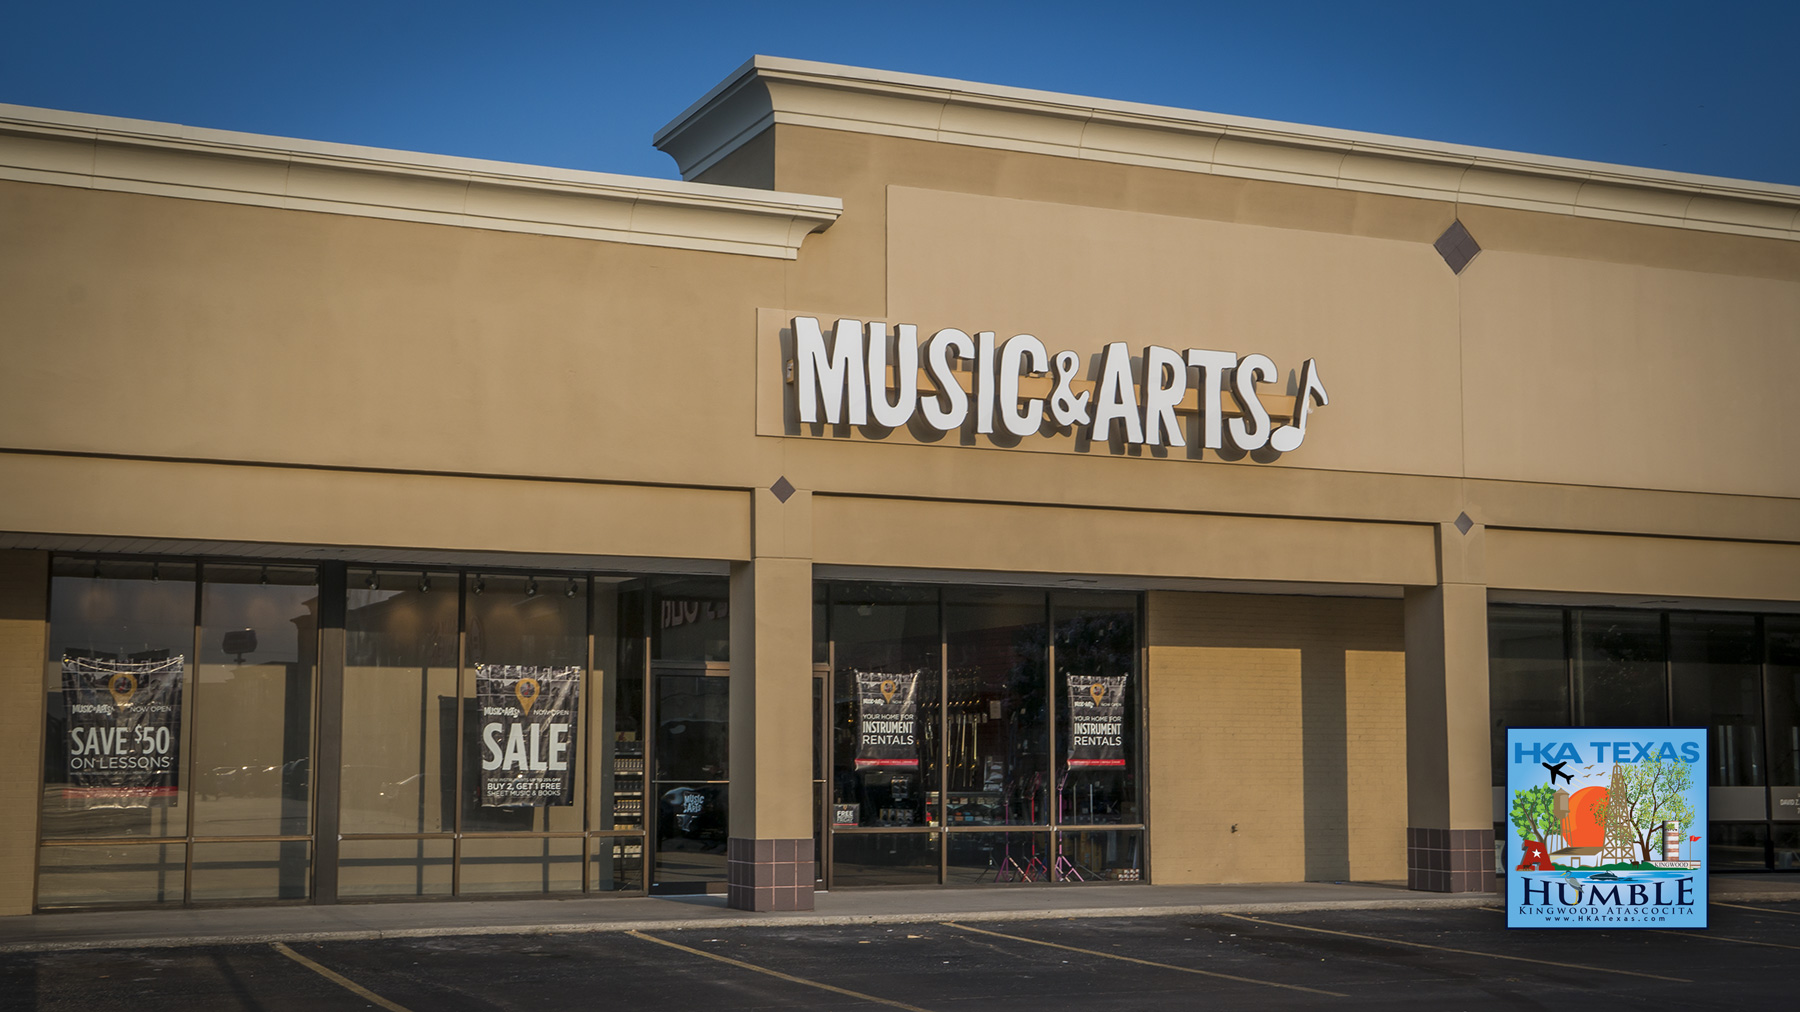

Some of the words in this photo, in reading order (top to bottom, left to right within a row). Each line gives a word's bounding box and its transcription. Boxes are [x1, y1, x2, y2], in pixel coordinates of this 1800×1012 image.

[130, 705, 149, 713] NOW
[150, 705, 172, 713] OPEN
[901, 713, 914, 721] FOR
[863, 721, 914, 734] INSTRUMENT
[1074, 722, 1122, 735] INSTRUMENT
[71, 726, 128, 756] SAVE
[134, 723, 170, 755] $50
[863, 735, 914, 745] RENTALS
[1074, 736, 1122, 746] RENTALS
[482, 722, 568, 771] SALE
[70, 757, 95, 769] ON
[487, 782, 505, 790] BUY
[516, 782, 533, 790] GET
[535, 782, 539, 790] 1
[540, 782, 561, 790] FREE
[684, 794, 705, 804] MUSIC
